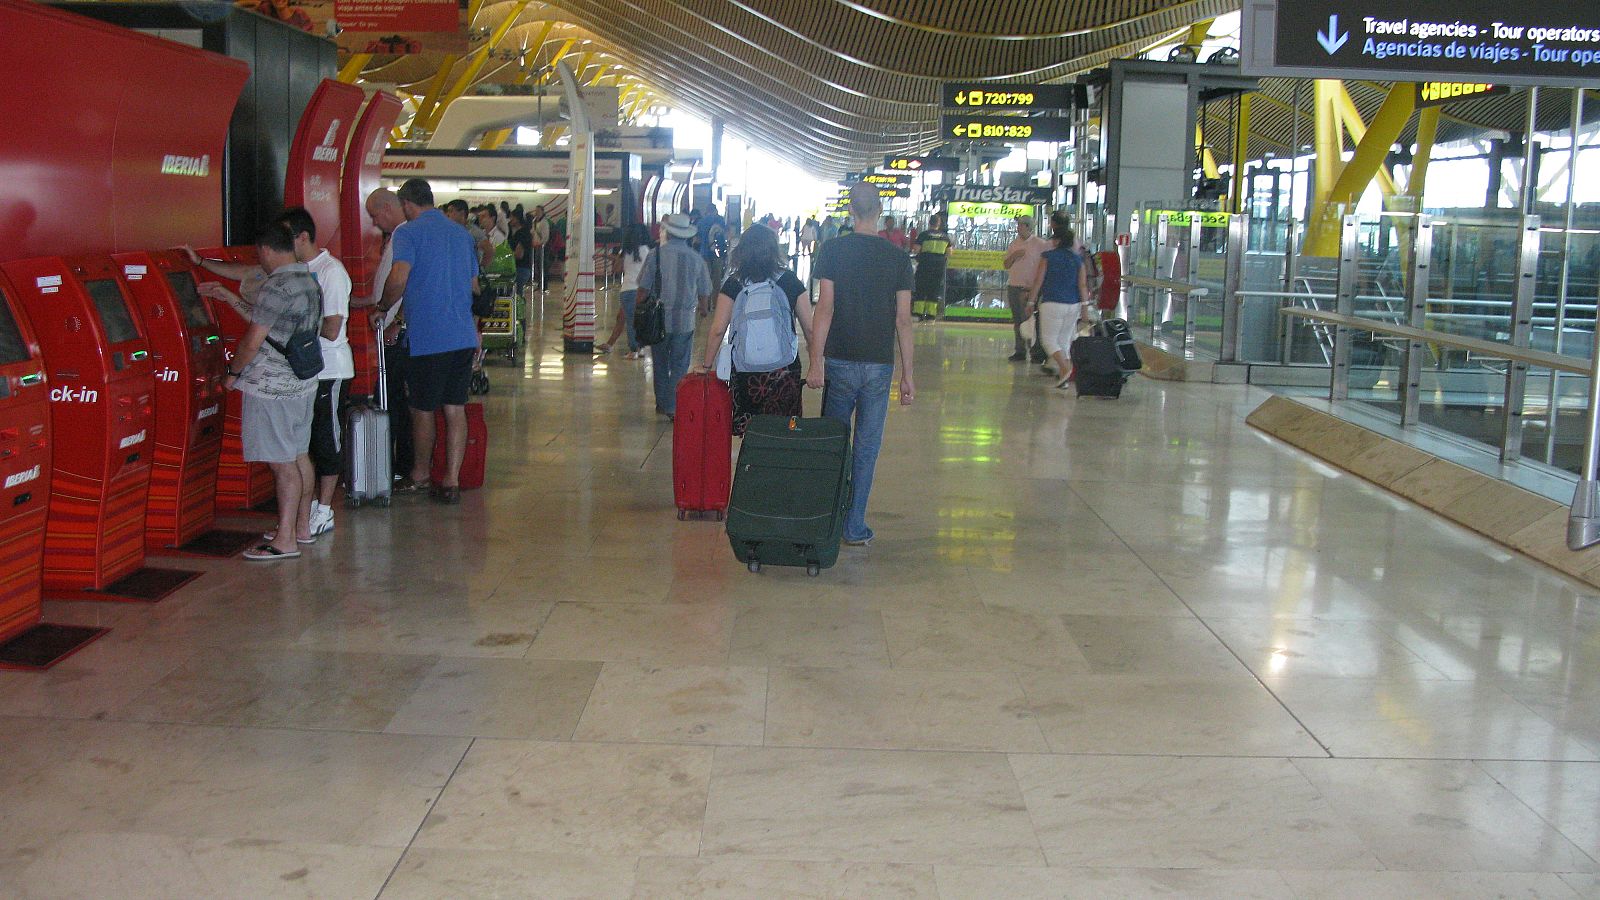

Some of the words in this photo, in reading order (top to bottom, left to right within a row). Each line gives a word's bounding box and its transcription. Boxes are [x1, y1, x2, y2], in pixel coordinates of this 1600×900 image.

[373, 4, 382, 12] de
[383, 4, 404, 12] volver
[1362, 17, 1407, 35] Travel
[1410, 21, 1477, 39] agencies
[1491, 22, 1525, 40] Tour
[1527, 26, 1600, 43] operators
[1362, 37, 1443, 60] Agencias
[1444, 41, 1467, 59] de
[1469, 42, 1520, 64] viajes
[1531, 44, 1569, 63] Tour
[312, 146, 338, 162] IBERIA
[161, 155, 200, 176] IBERIA
[382, 161, 416, 169] BERIA
[952, 185, 1031, 203] TrueStar
[959, 204, 1023, 219] SecureBag
[119, 431, 144, 449] IBERIA
[4, 467, 37, 489] IBERIA
